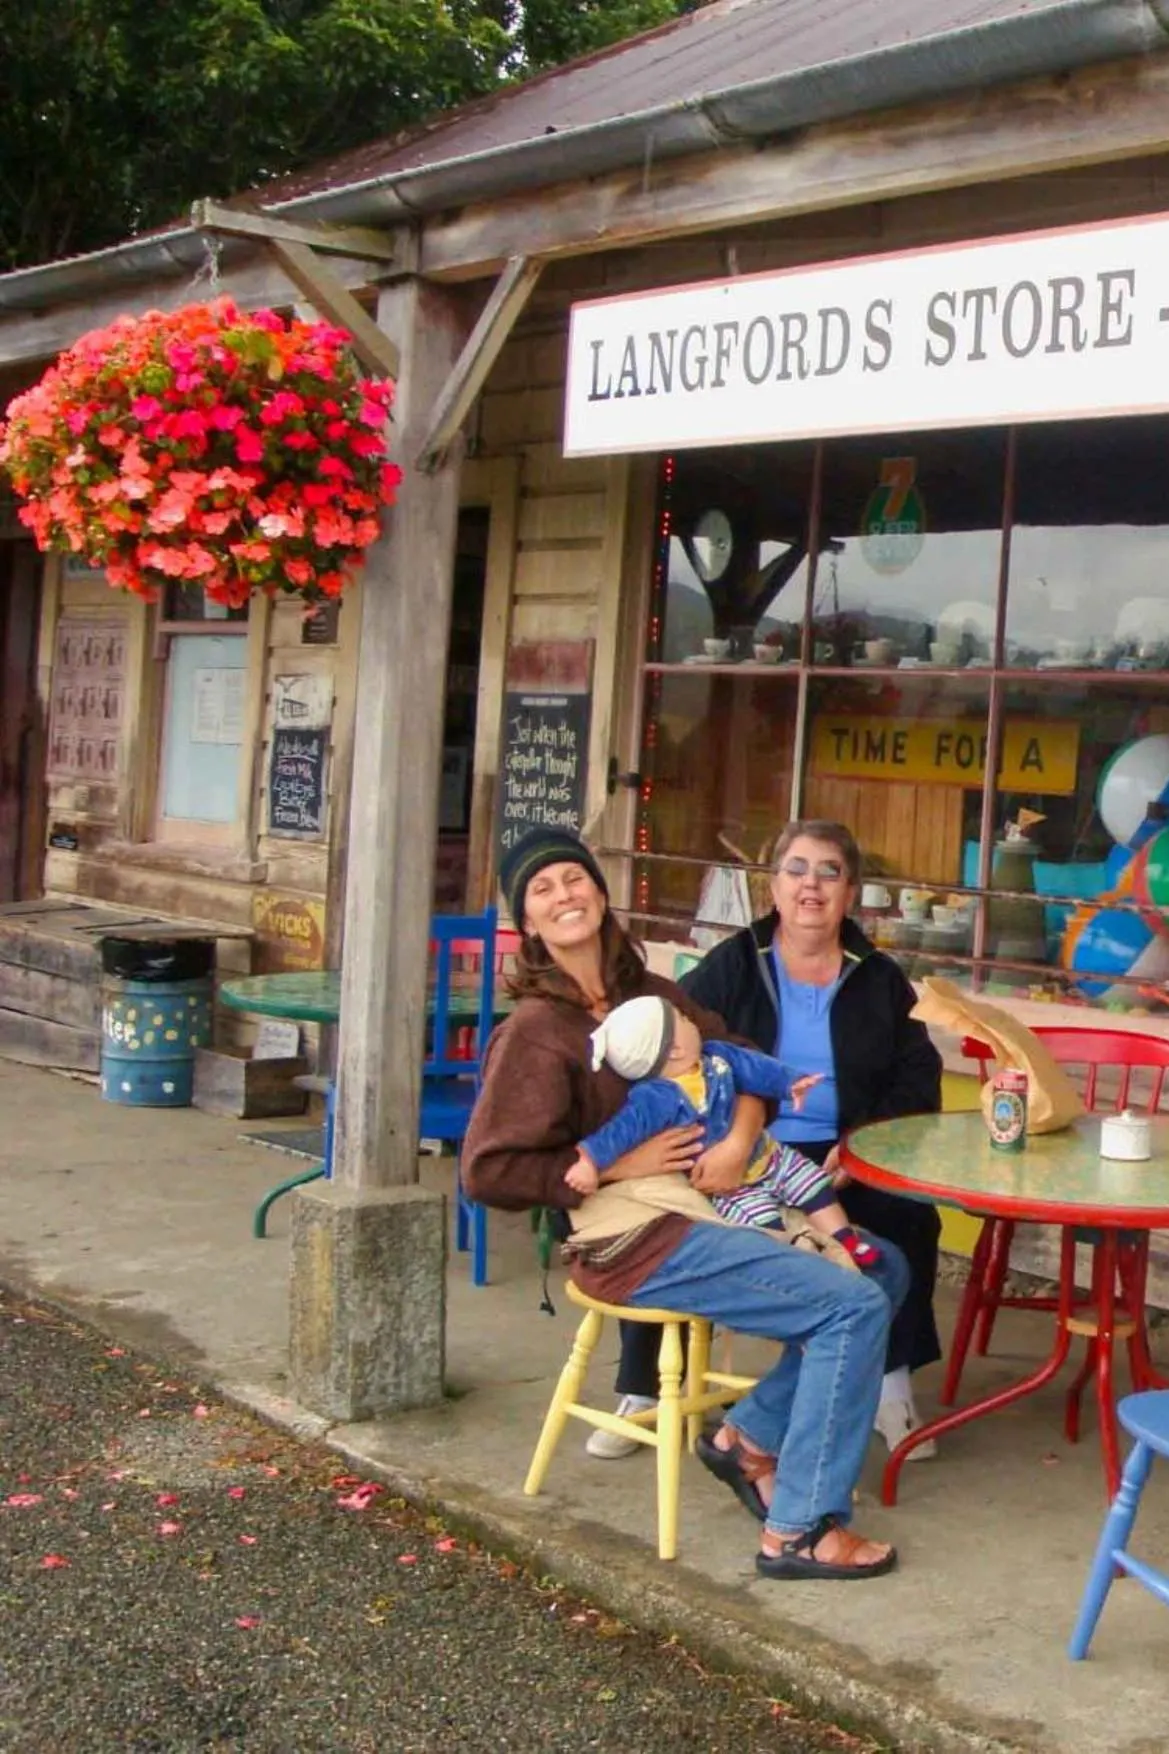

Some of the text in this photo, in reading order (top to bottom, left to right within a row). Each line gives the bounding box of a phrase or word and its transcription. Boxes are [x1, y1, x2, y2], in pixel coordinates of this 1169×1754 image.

[587, 299, 893, 402] LANGFORDS
[924, 273, 1135, 366] STORE
[831, 728, 908, 765] TIME
[1019, 738, 1044, 772] A
[505, 774, 572, 802] the world was
